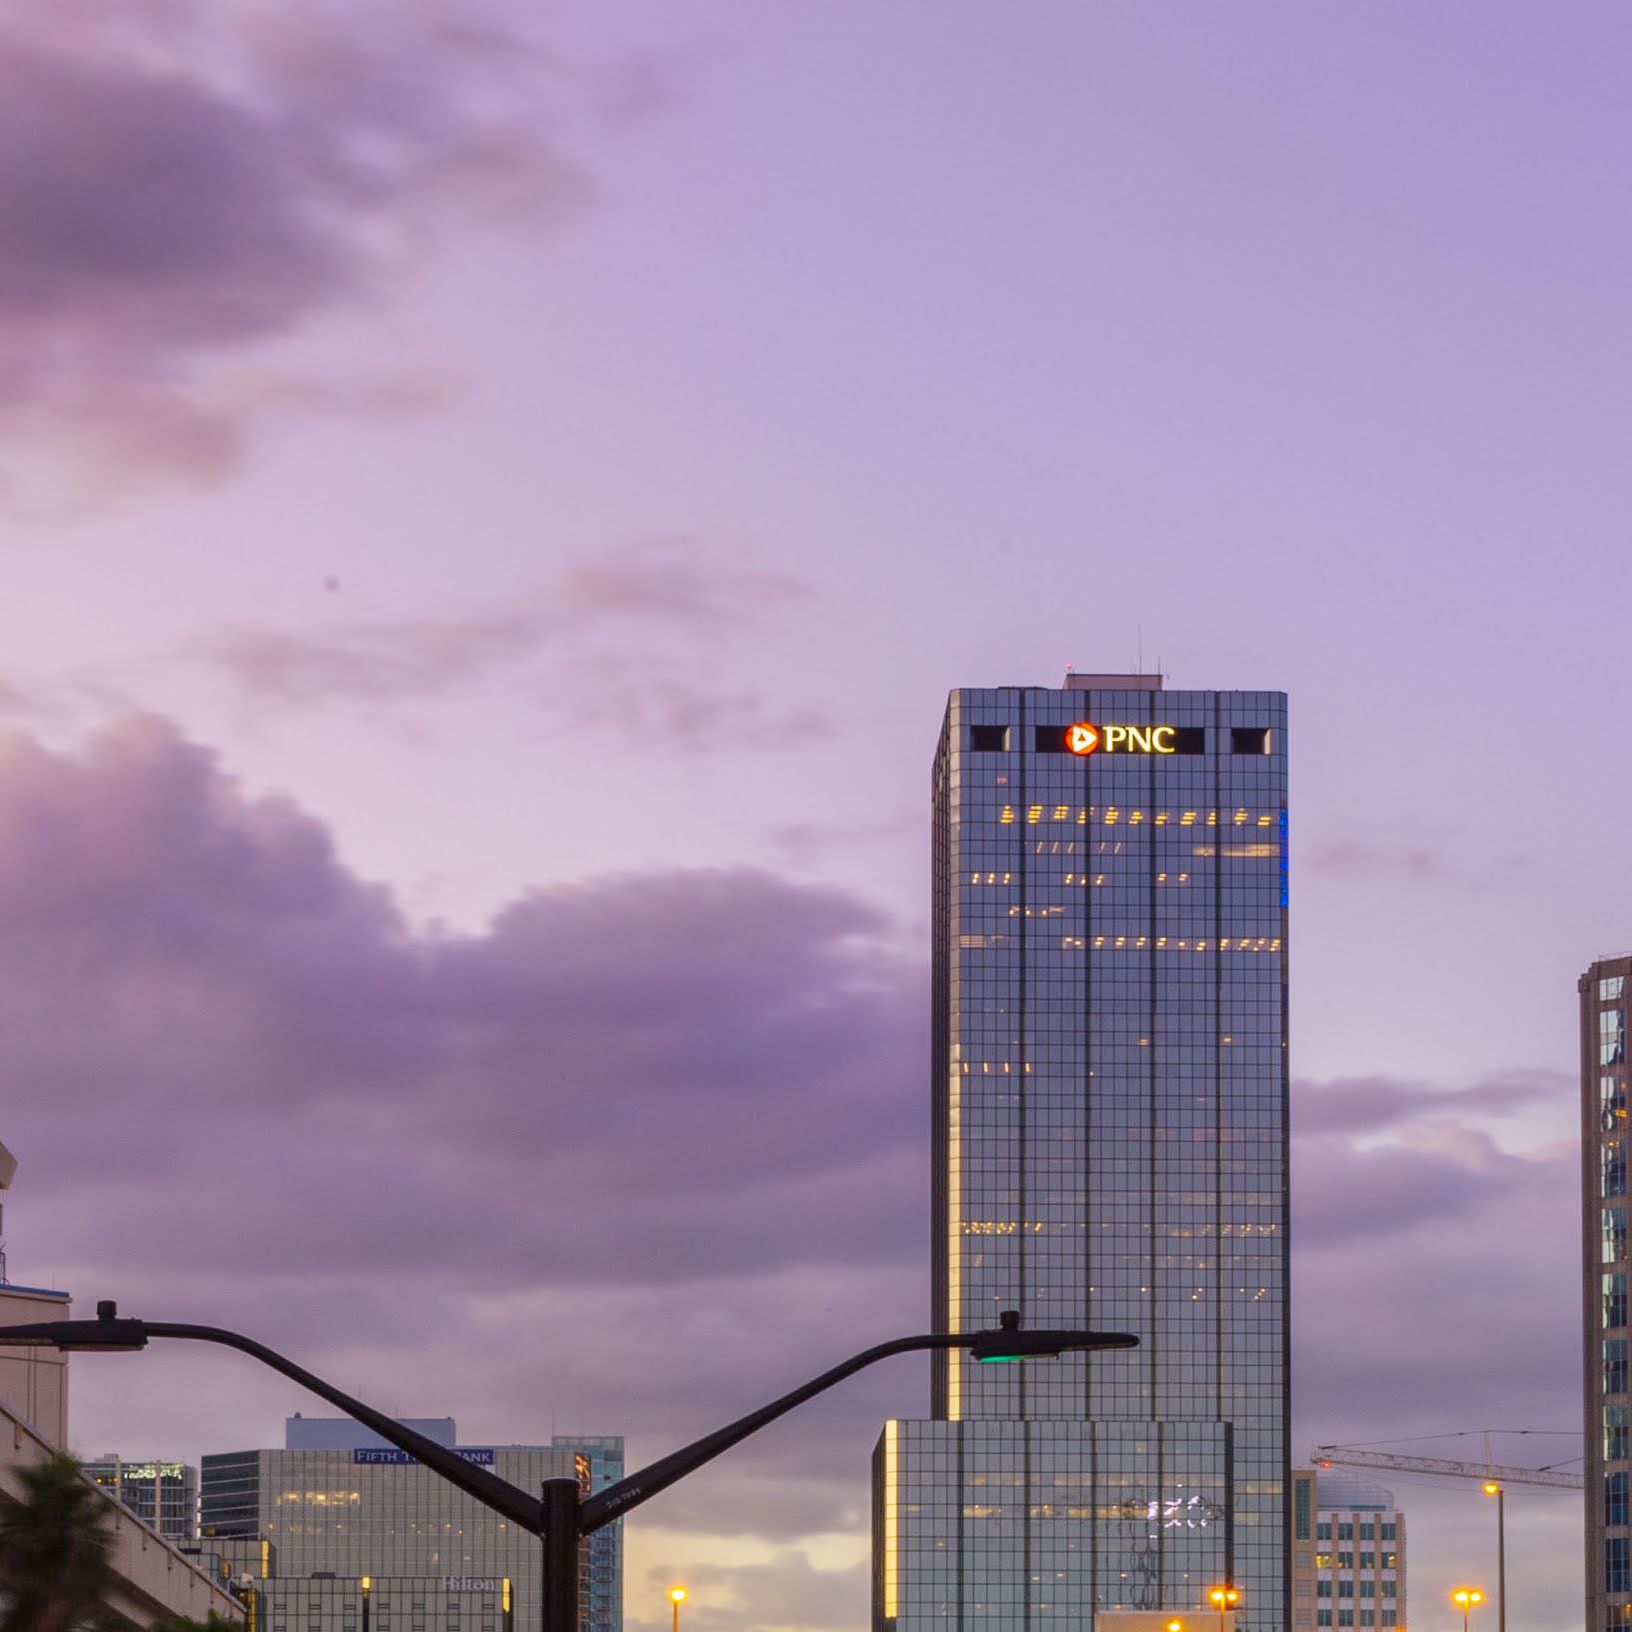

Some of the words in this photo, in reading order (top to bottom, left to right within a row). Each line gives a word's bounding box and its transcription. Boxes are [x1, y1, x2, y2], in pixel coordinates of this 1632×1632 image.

[1102, 725, 1176, 754] PNC
[357, 1450, 397, 1462] FIFTH
[442, 1576, 495, 1591] Hilton
